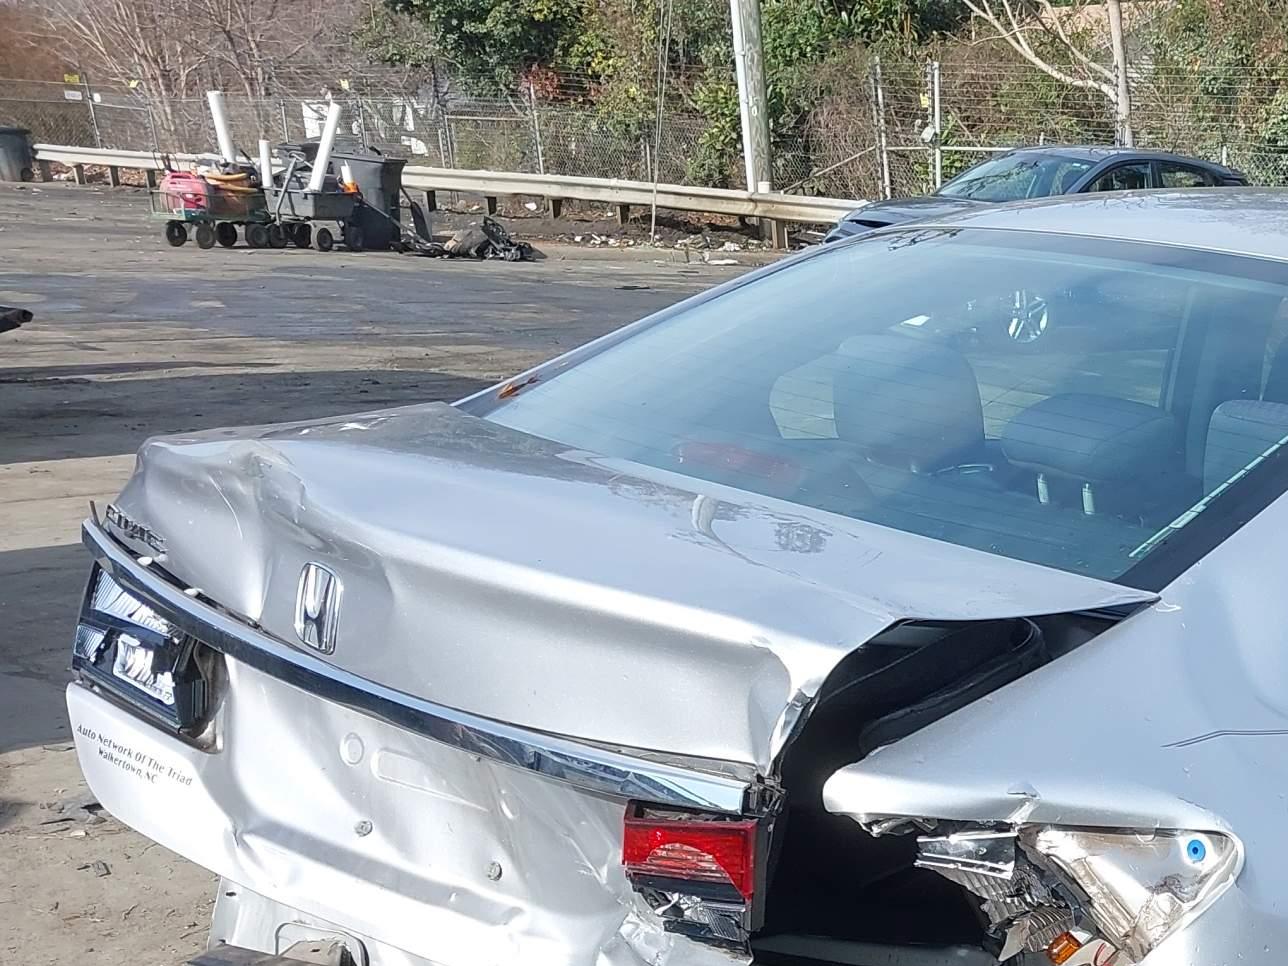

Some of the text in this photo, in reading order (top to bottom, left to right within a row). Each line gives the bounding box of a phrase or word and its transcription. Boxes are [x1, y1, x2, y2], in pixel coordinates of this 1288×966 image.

[76, 724, 193, 787] Auto Network Of The Triad
[98, 746, 159, 784] Walkertown, NC
